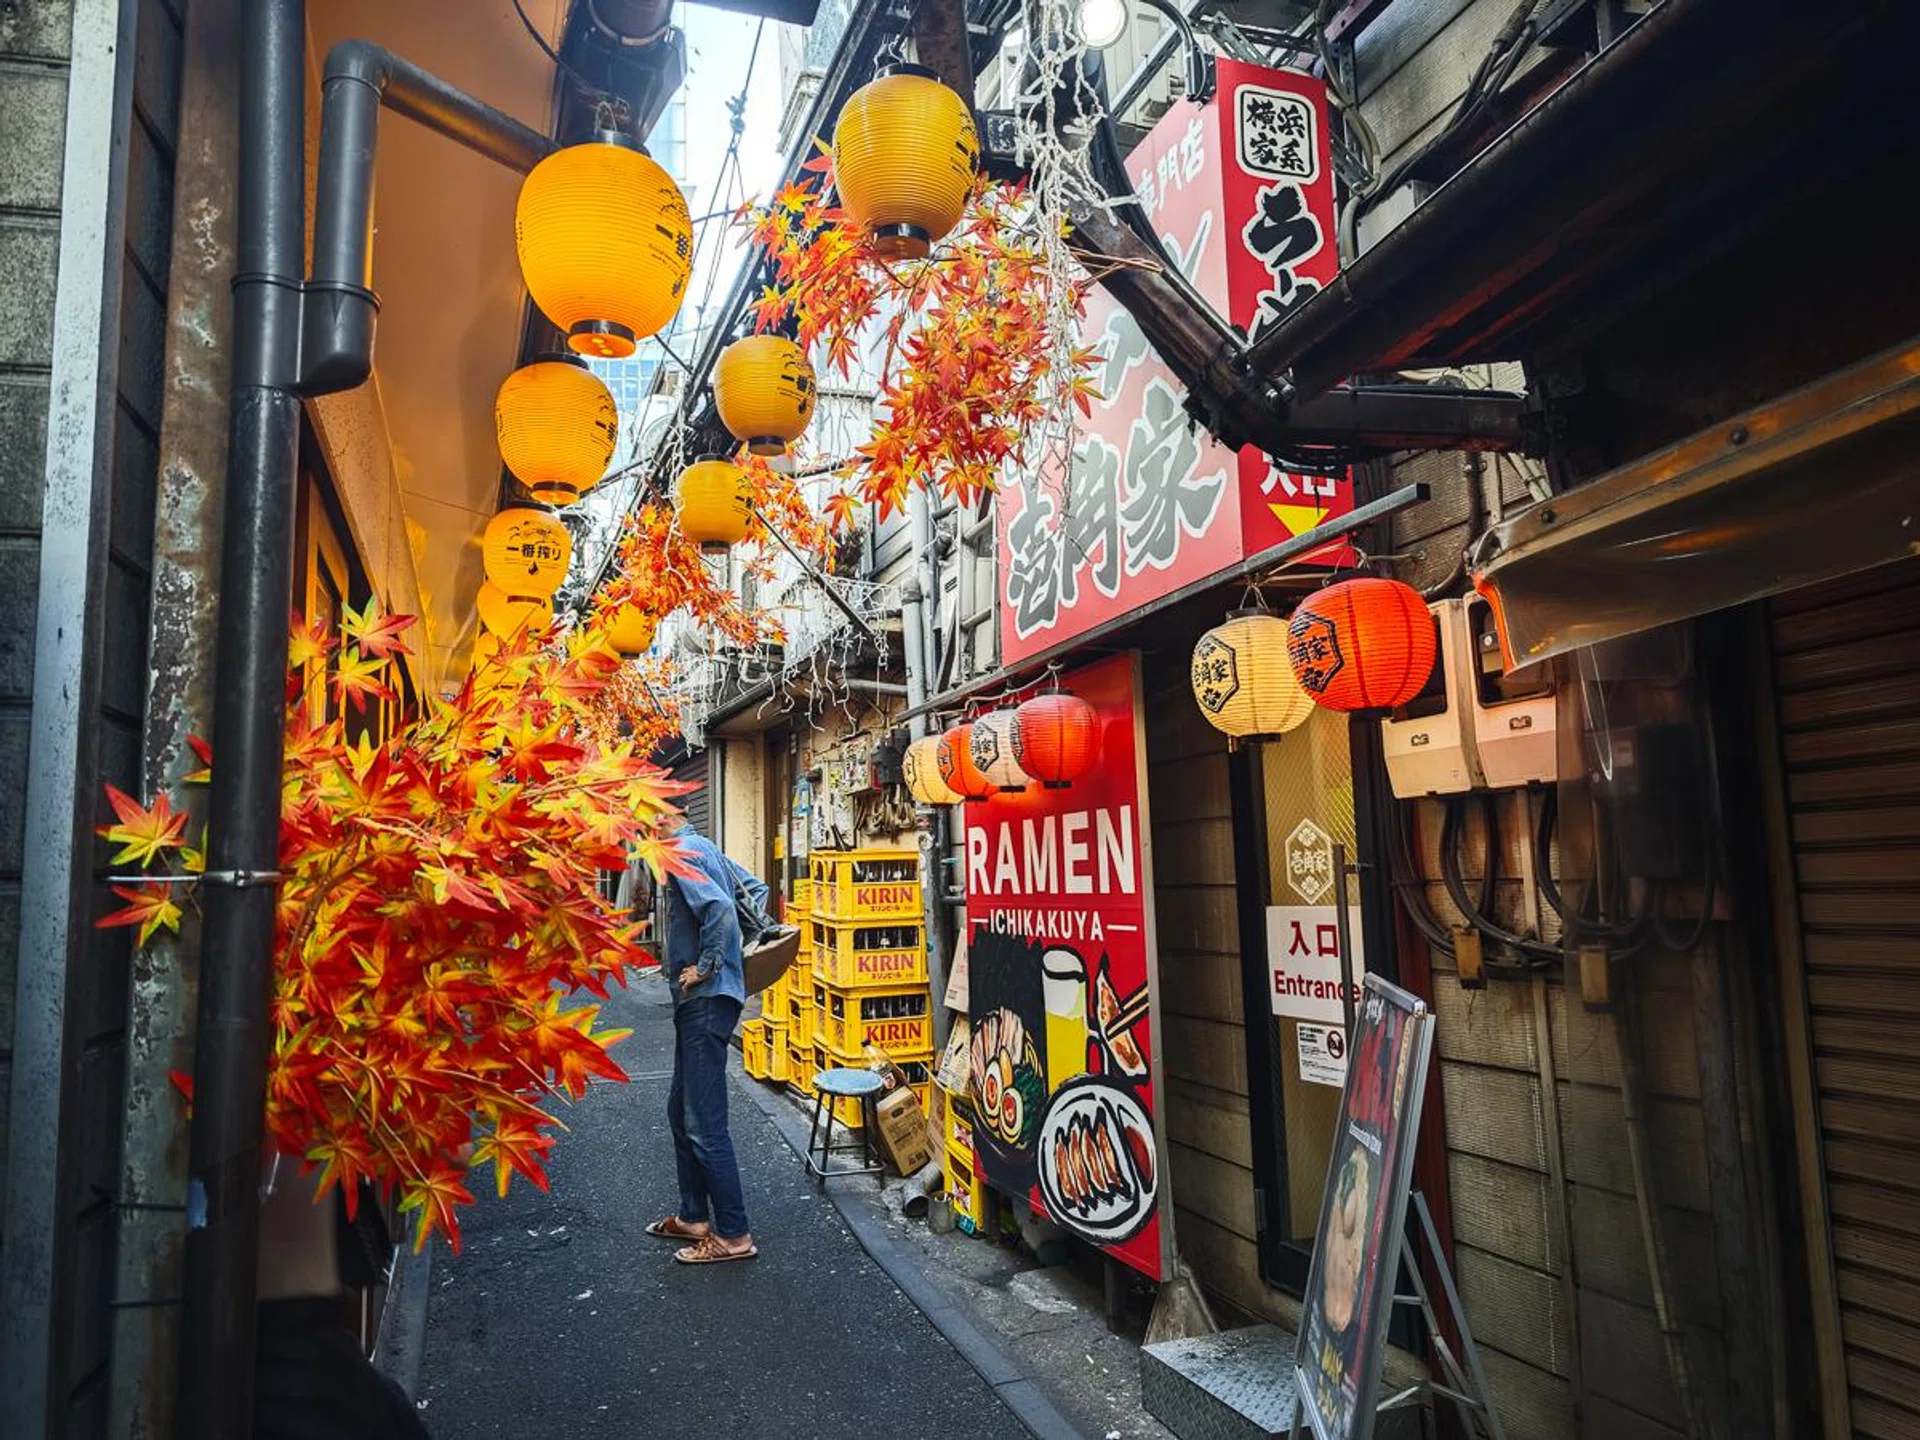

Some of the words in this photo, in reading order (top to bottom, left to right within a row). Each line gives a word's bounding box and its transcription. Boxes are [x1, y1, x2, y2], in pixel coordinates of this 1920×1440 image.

[1246, 97, 1306, 139] 横浜
[1250, 132, 1306, 173] 家系
[506, 543, 561, 561] 一番搾り
[967, 804, 1136, 895] RAMEN
[857, 886, 914, 905] KIRIN
[990, 908, 1104, 942] ICHIKAKUYA
[1288, 921, 1339, 958] 入口
[858, 953, 914, 973] KIRIN
[866, 1021, 922, 1044] KIRIN
